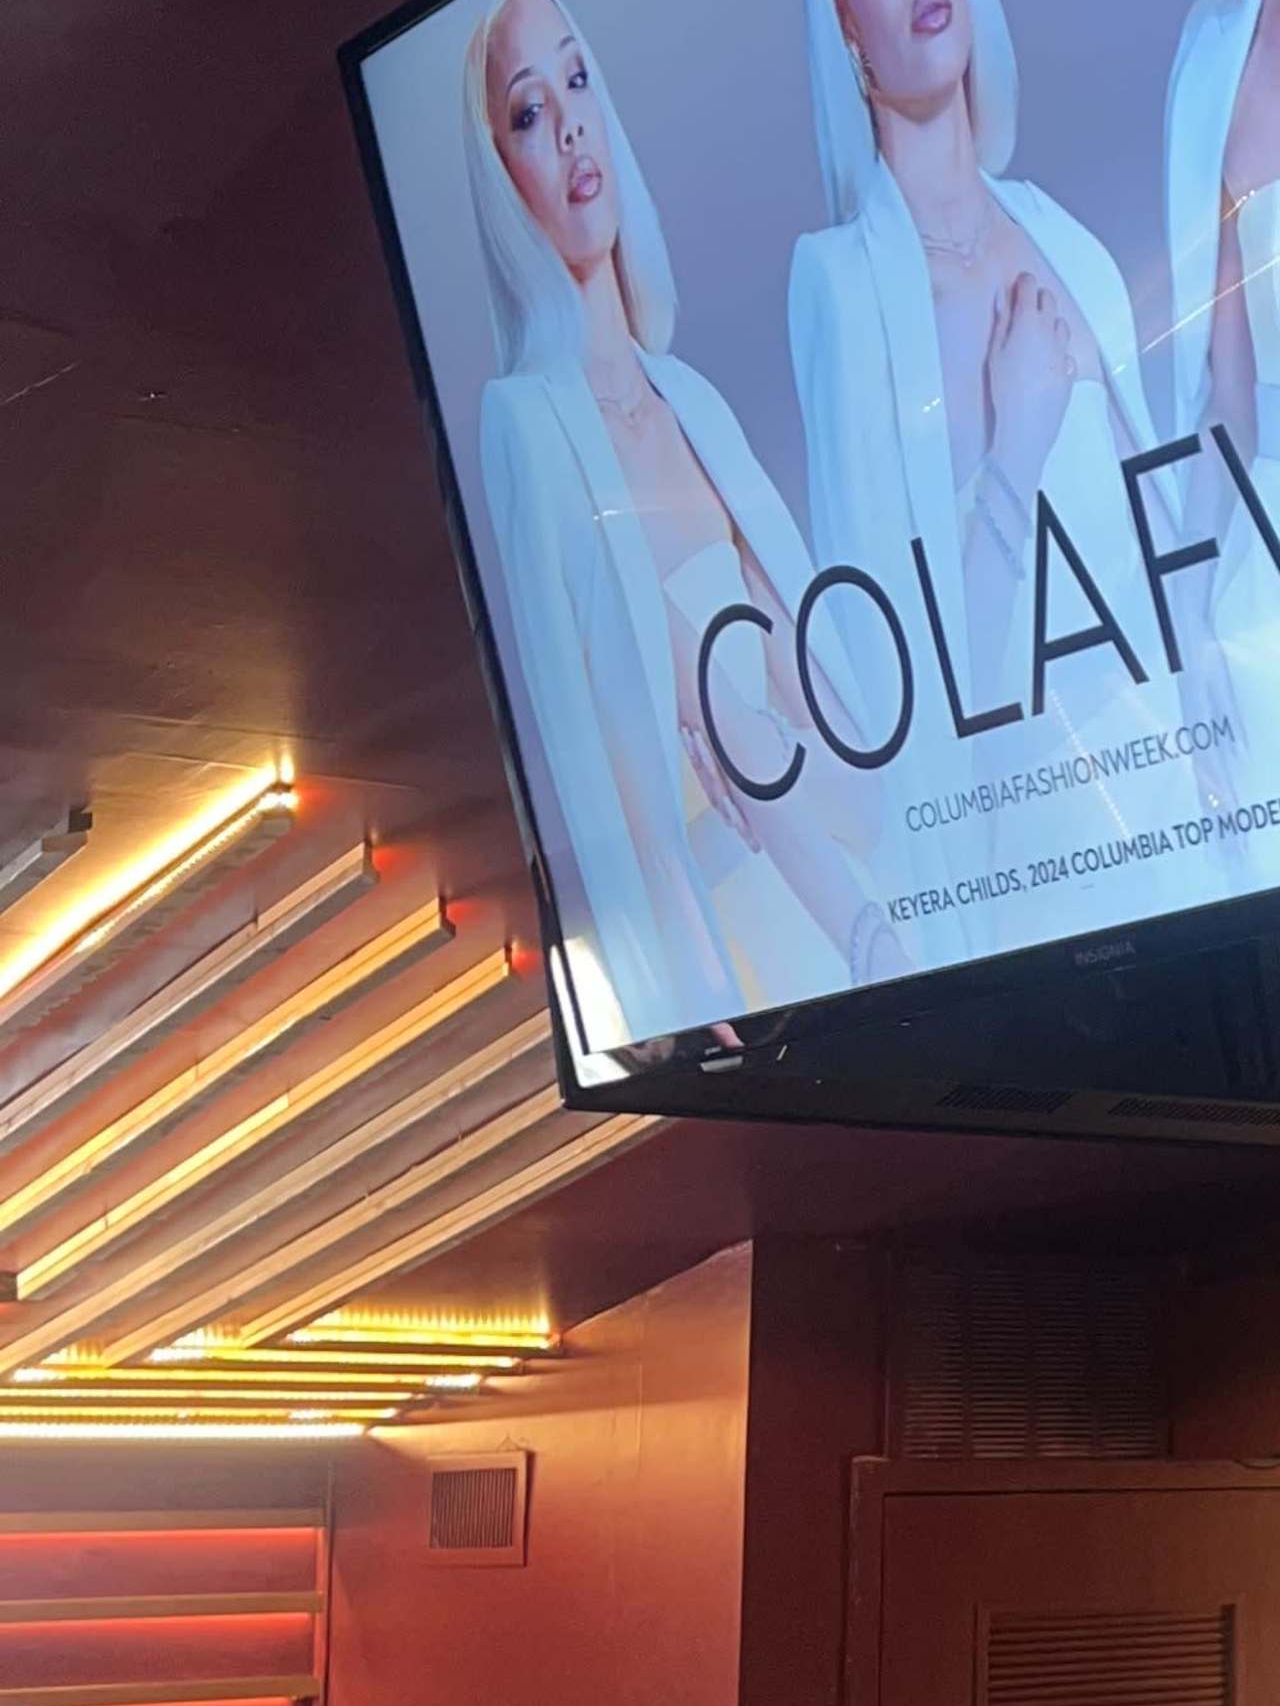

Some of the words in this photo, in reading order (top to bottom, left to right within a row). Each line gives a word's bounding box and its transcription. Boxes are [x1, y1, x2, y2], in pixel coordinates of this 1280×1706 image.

[905, 715, 1236, 831] COLUMBIAFASHIONWEEK.COM
[887, 887, 956, 924] KEYERA
[956, 869, 1027, 905] CHILDS,
[1027, 861, 1070, 889] 2024
[1071, 830, 1174, 877] COLUMBIA
[1173, 818, 1213, 850] TOP
